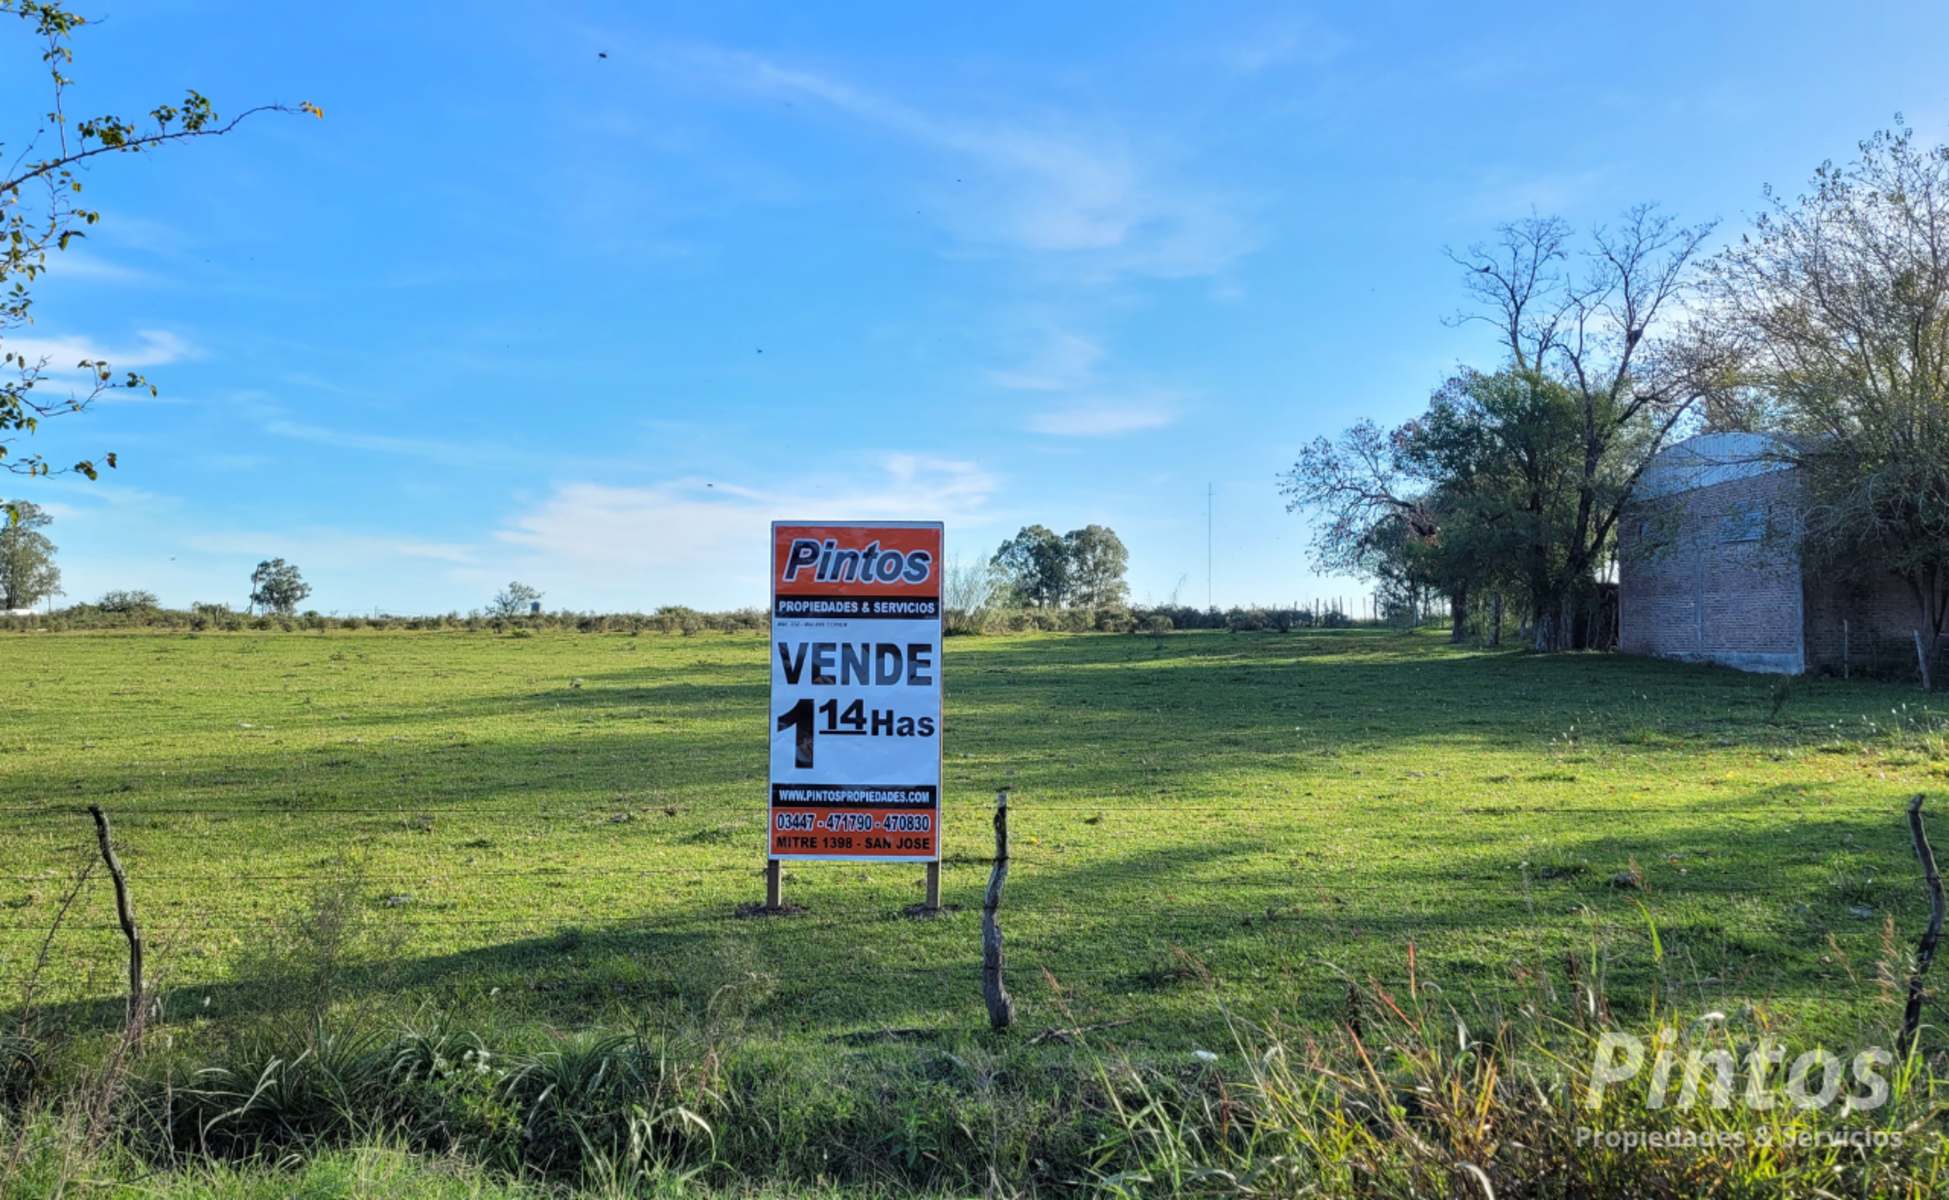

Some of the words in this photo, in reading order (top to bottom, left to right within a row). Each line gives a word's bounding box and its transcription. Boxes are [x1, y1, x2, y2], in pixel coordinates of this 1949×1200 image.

[783, 539, 932, 584] Pintos
[779, 601, 858, 613] PROPIEDADES
[861, 602, 870, 613] &
[873, 602, 935, 614] SERVICIOS
[777, 642, 932, 686] VENDE
[871, 709, 935, 737] Has
[779, 790, 930, 803] WWW.PINTOSPROPIEDADES.COM
[776, 813, 815, 830] 03447
[825, 813, 872, 831] 471790
[882, 814, 931, 831] 470830
[776, 836, 817, 848] MITRE
[822, 837, 853, 849] 1398
[864, 837, 891, 849] SAN
[896, 838, 930, 850] JOSE
